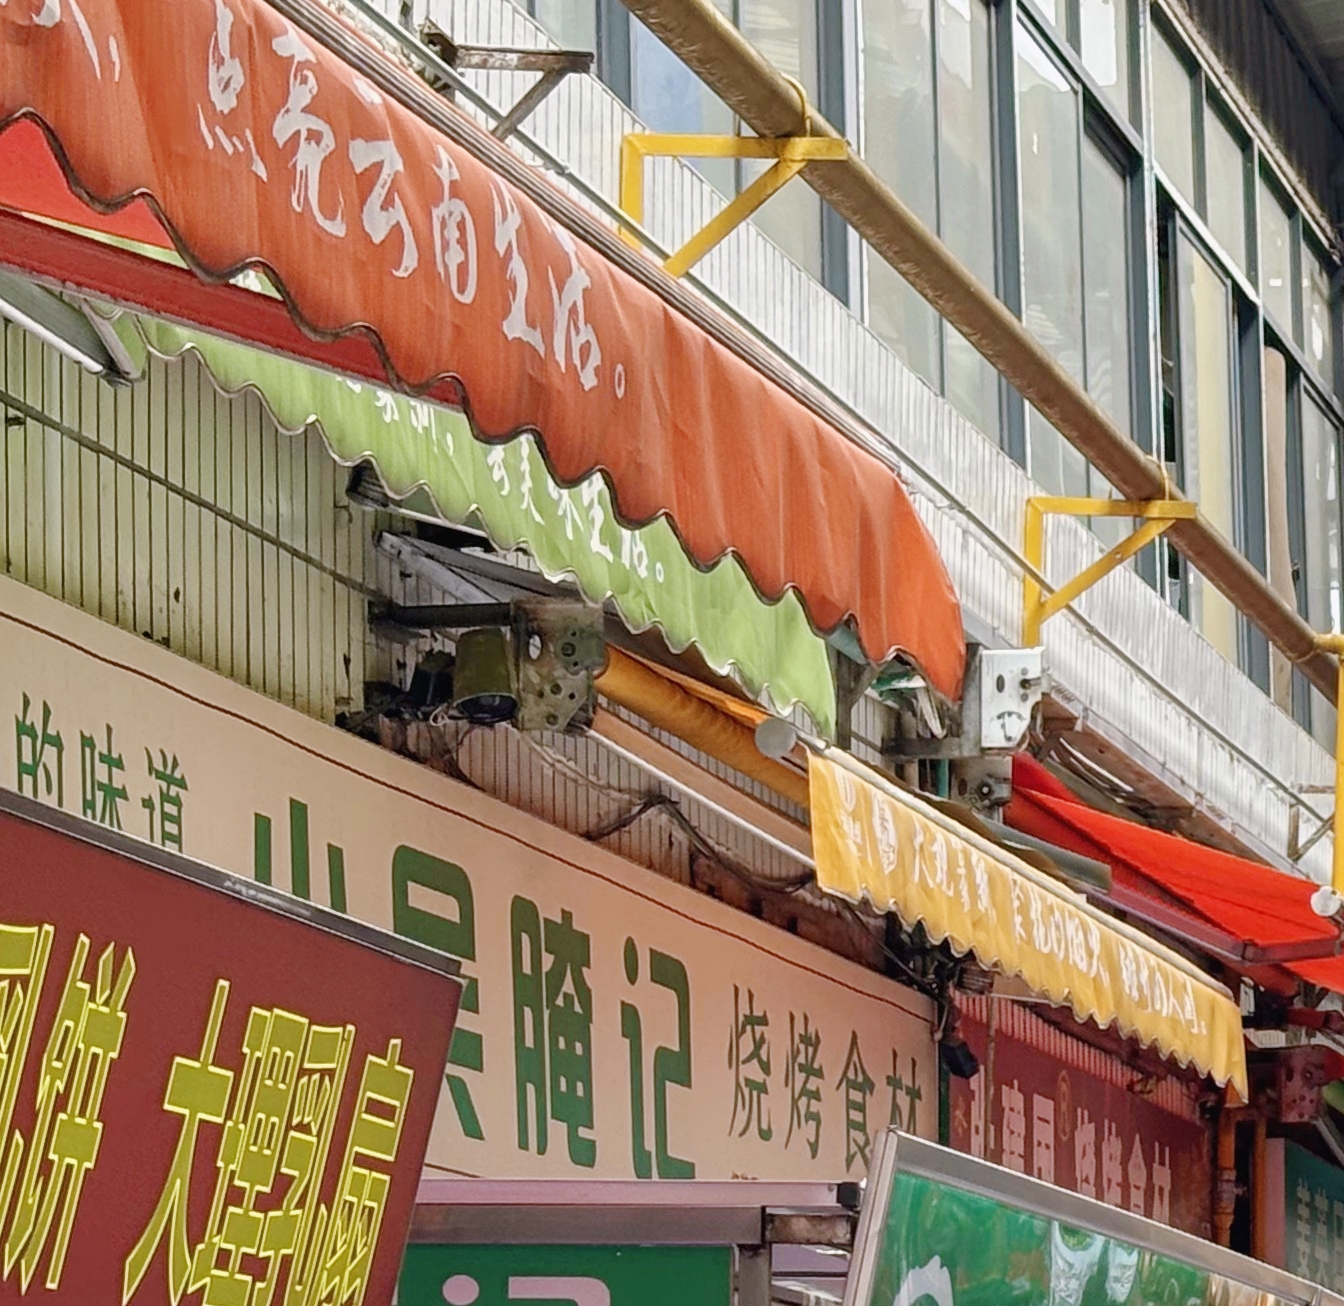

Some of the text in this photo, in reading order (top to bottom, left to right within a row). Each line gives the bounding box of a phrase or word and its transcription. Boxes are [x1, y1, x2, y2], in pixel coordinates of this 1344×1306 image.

[14, 690, 189, 852] 的味道
[728, 984, 923, 1173] 烧烤食材
